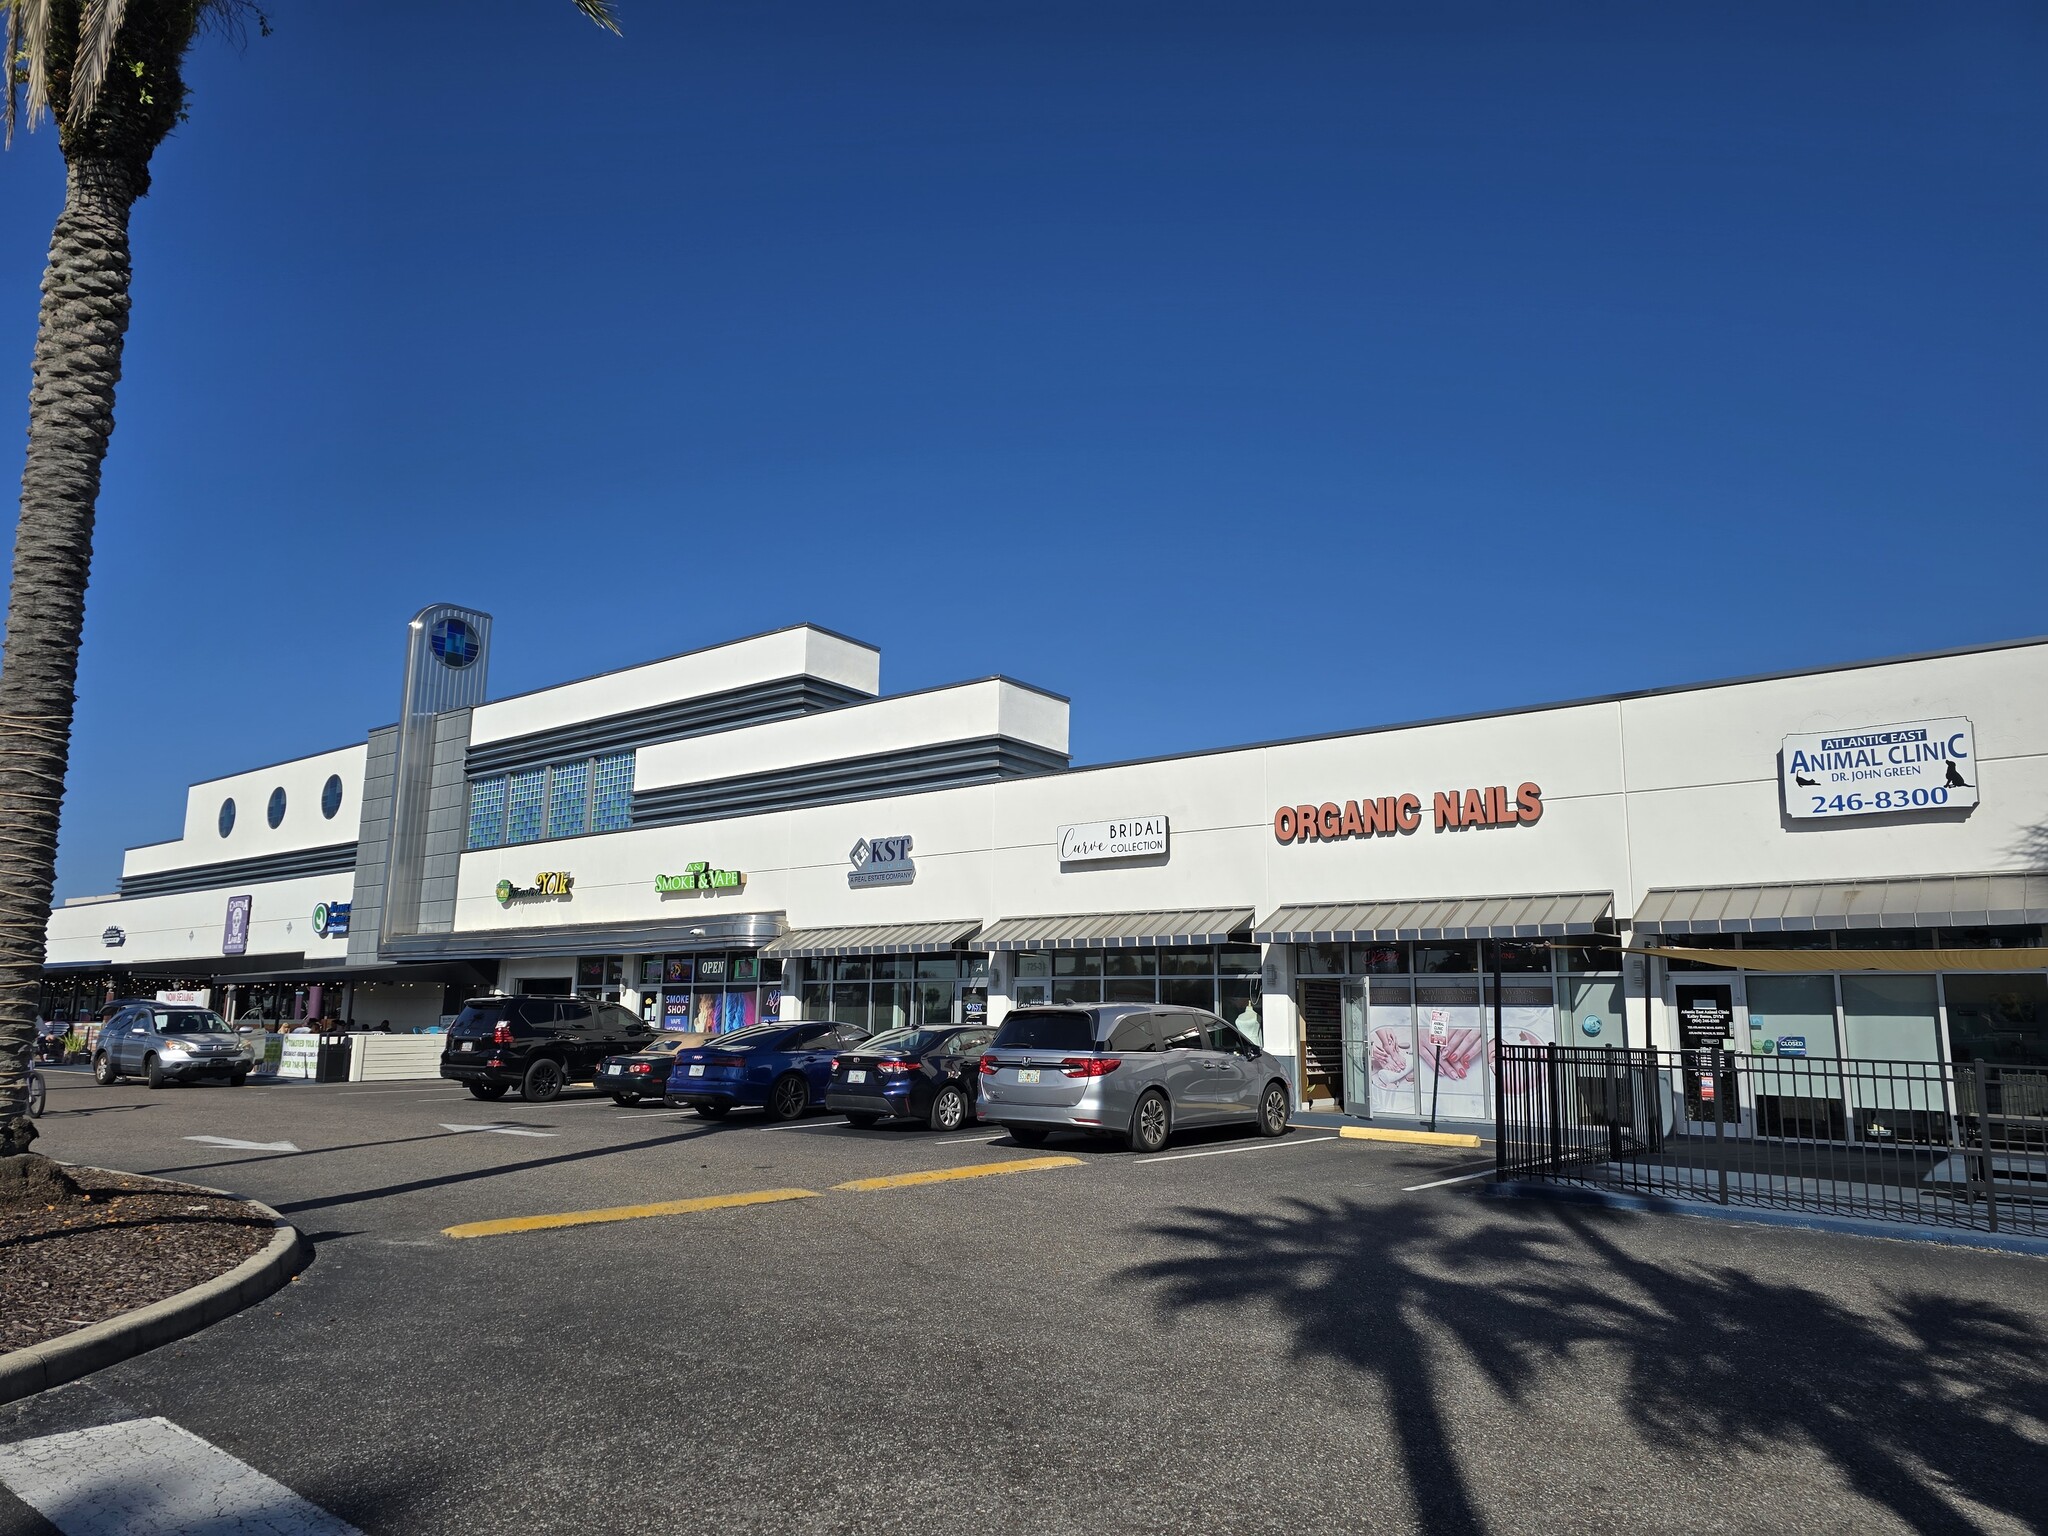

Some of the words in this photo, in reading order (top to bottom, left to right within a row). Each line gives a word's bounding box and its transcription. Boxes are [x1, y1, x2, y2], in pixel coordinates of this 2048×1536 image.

[1824, 734, 1888, 750] ATLANTIC
[1889, 730, 1924, 744] EAST
[1789, 748, 1883, 774] ANIMAL
[1888, 733, 1968, 766] CLINIC
[1831, 771, 1850, 783] DR.
[1852, 768, 1882, 783] JOHN
[1884, 765, 1921, 778] GREEN
[1811, 787, 1949, 814] 246-8300
[1274, 793, 1422, 842] ORGANIC
[1433, 782, 1542, 829] NAILS
[1110, 820, 1162, 839] BRIDAL
[871, 838, 910, 863] KST
[1062, 828, 1108, 858] Curve
[1110, 840, 1163, 853] COLLECTION
[536, 872, 568, 894] Yolk
[655, 874, 695, 892] SMOKE
[698, 873, 709, 889] &
[708, 869, 738, 888] VAPE
[1362, 949, 1400, 966] Open
[702, 961, 724, 974] OPEN
[166, 993, 176, 1001] NOW
[177, 993, 194, 1001] SELLING
[666, 995, 689, 1004] SMOKE
[667, 1005, 686, 1014] SHOP
